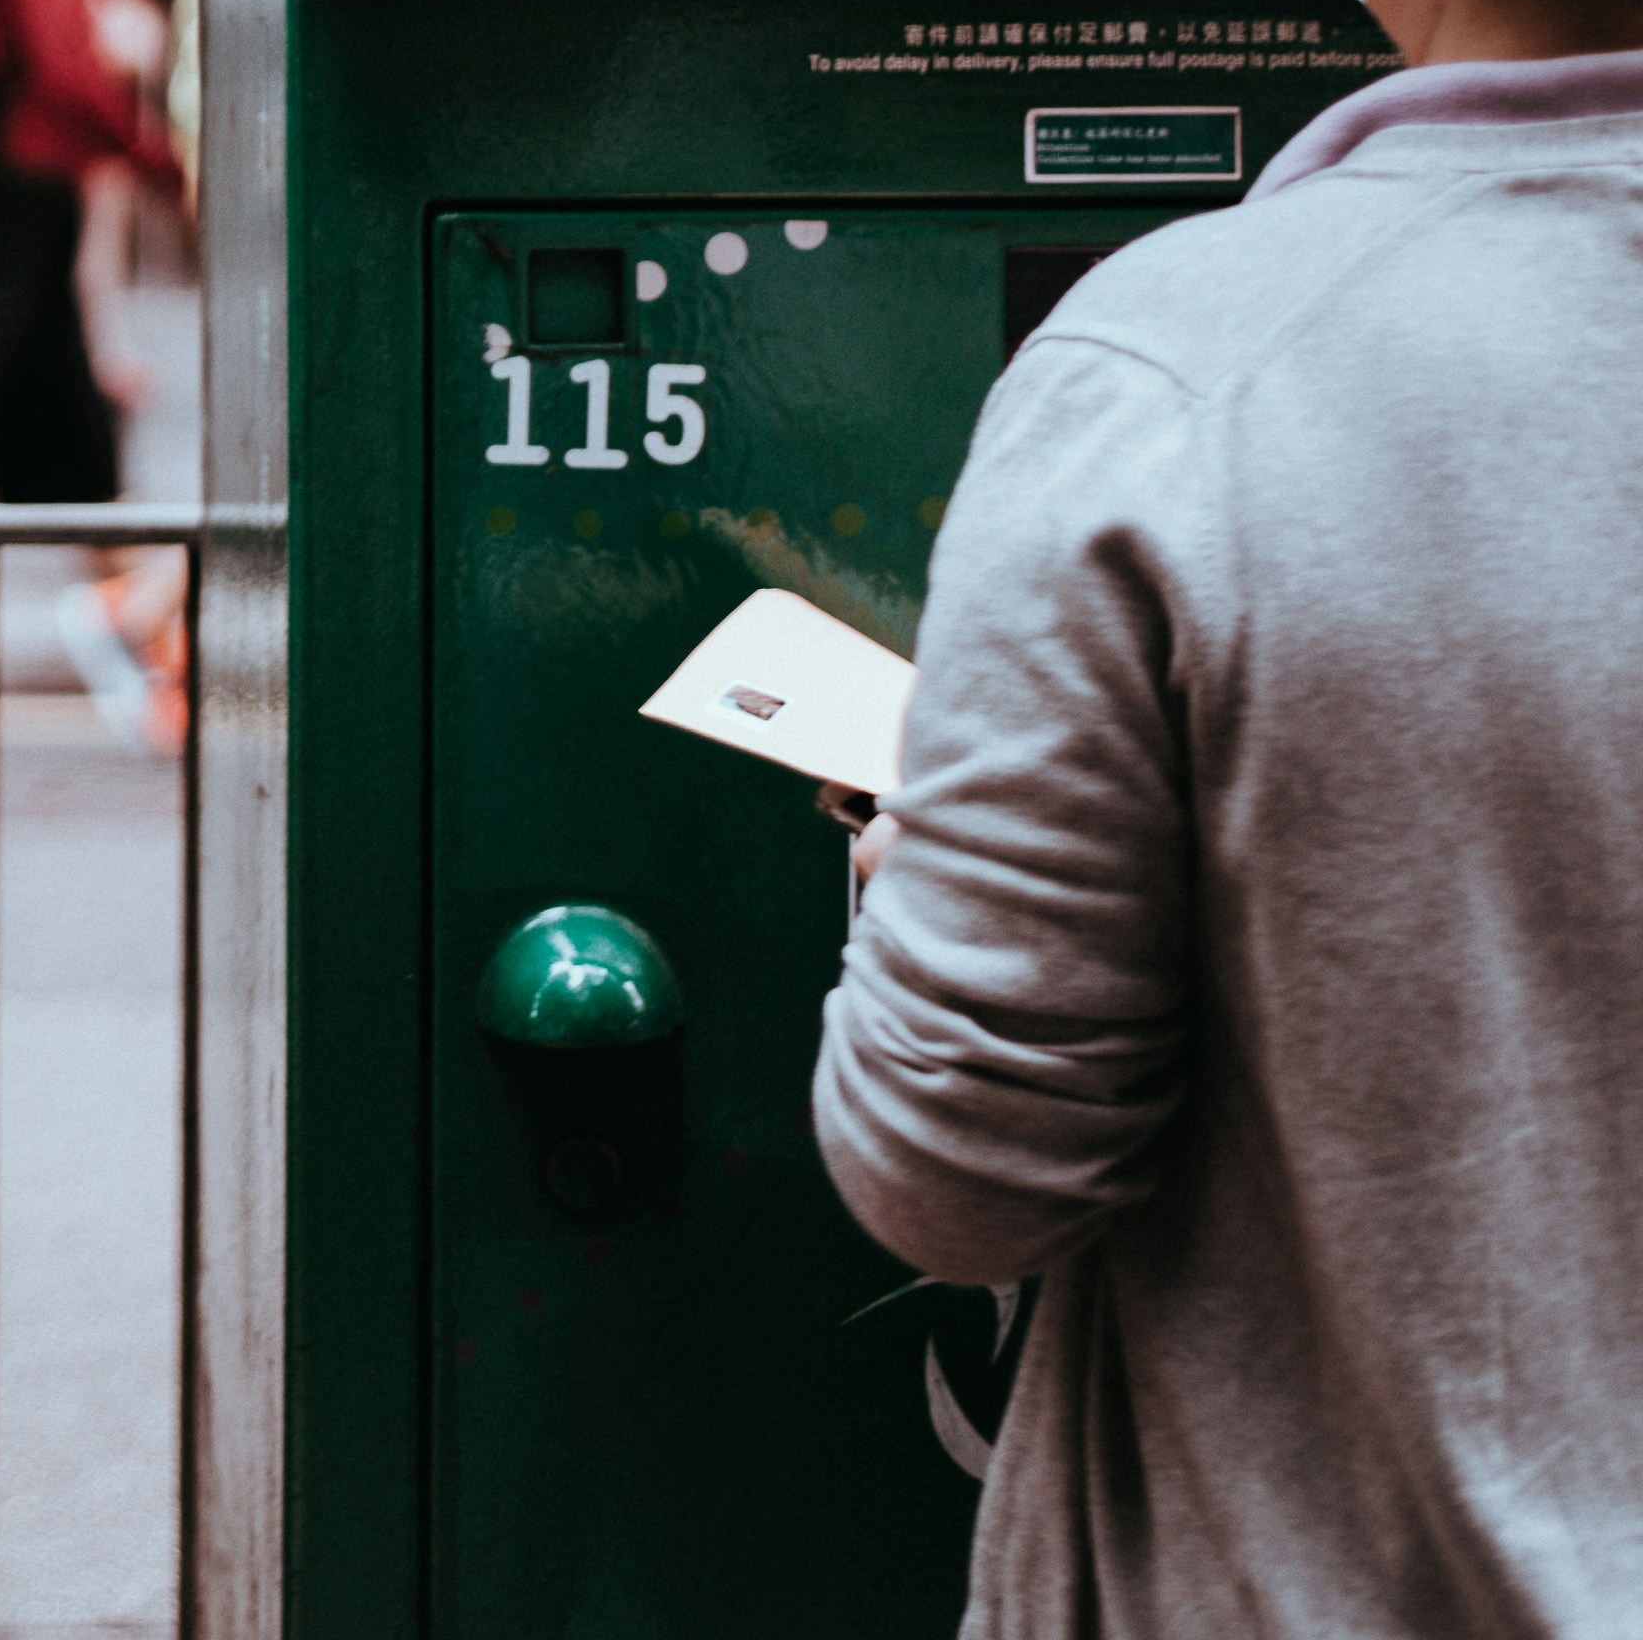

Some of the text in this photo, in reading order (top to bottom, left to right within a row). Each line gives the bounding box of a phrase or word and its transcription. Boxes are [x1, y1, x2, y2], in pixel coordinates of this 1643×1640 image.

[809, 54, 830, 71] To
[834, 54, 881, 71] avoid
[884, 54, 929, 74] delay
[933, 54, 949, 70] in
[1028, 53, 1082, 73] please
[1086, 53, 1144, 69] ensure
[1147, 51, 1175, 68] full
[1179, 52, 1245, 72] postage
[1249, 52, 1264, 68] is
[1268, 52, 1305, 70] paid
[1309, 50, 1362, 68] before
[485, 355, 706, 469] 115
